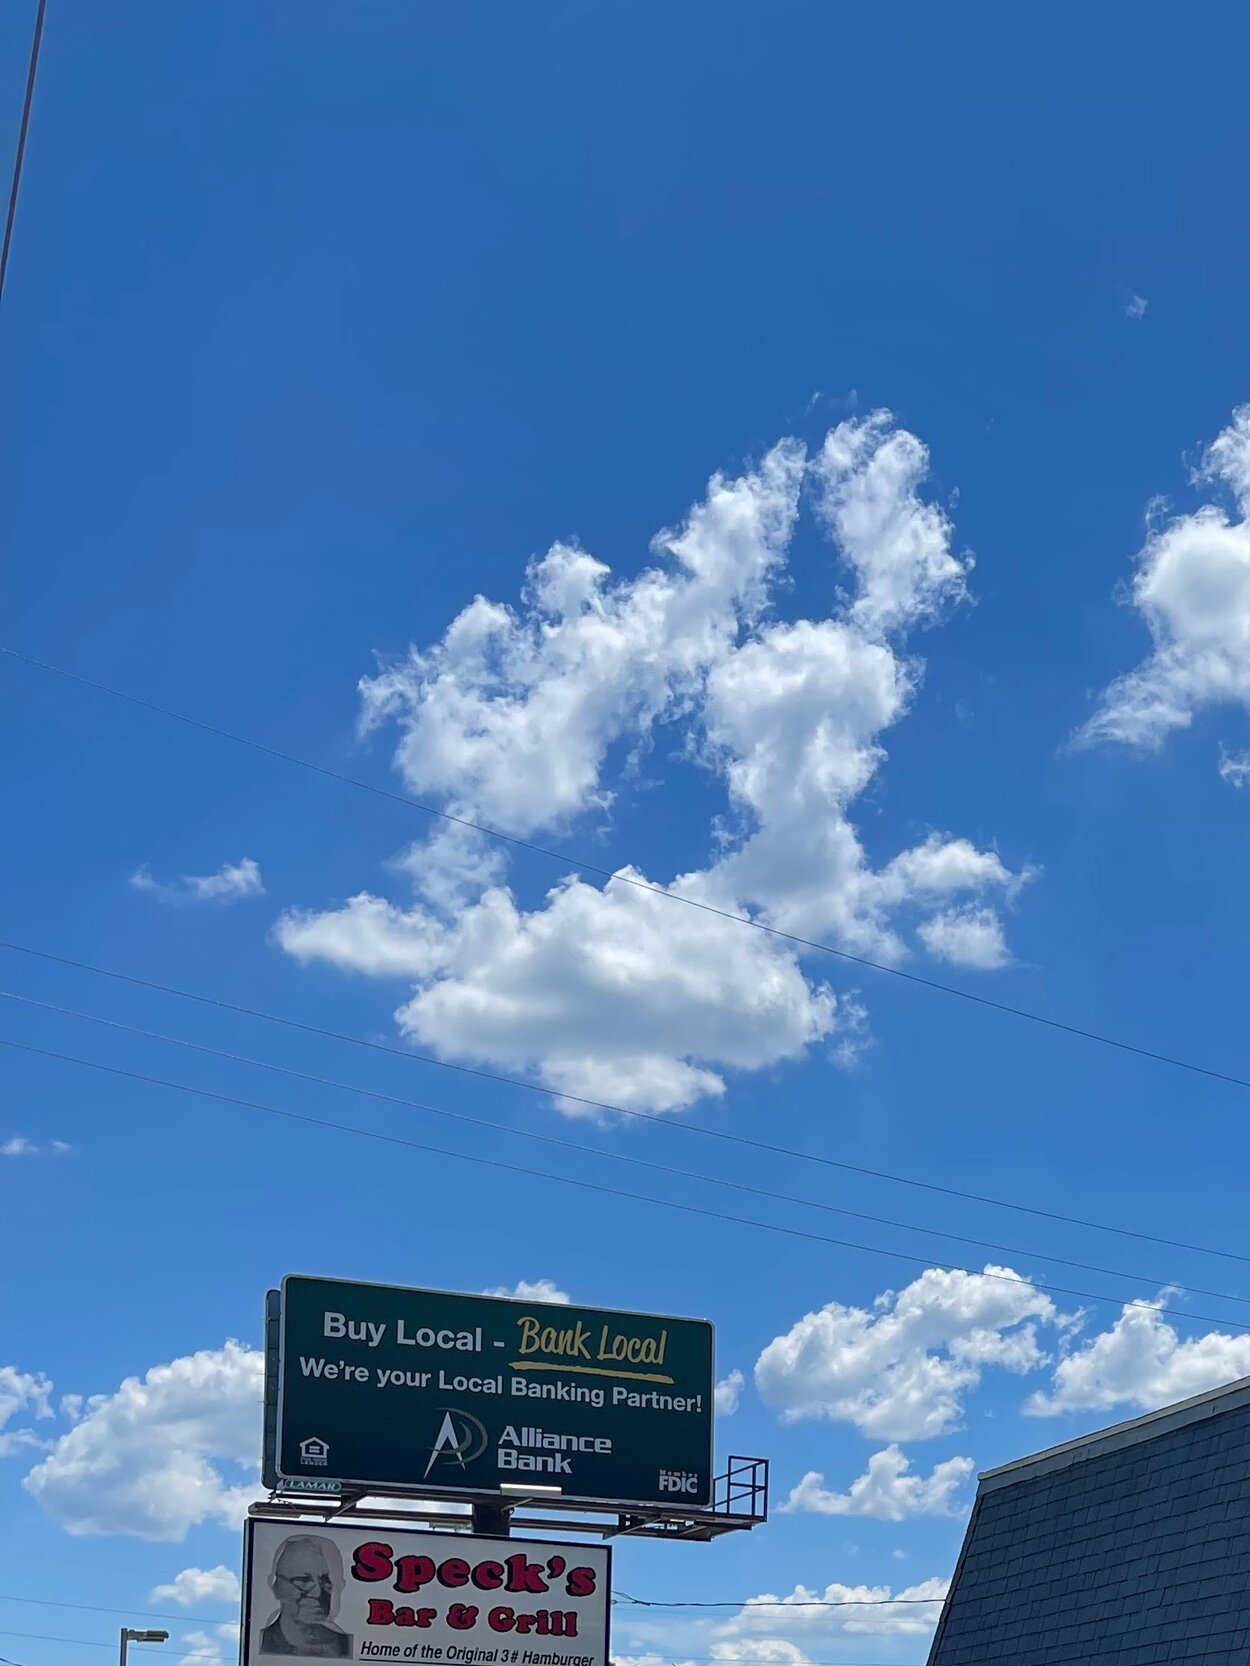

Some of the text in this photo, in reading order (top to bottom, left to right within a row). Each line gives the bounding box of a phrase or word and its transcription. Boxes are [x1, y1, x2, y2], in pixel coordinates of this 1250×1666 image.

[323, 1311, 386, 1347] Buy
[397, 1319, 482, 1352] Local
[516, 1316, 591, 1360] Bank
[597, 1325, 667, 1365] Local
[300, 1356, 702, 1413] We're your Local Banking Partner!
[497, 1425, 612, 1454] Alliance
[497, 1448, 573, 1474] Bank
[290, 1480, 336, 1490] LAMAR
[659, 1475, 698, 1494] FDIC
[351, 1541, 596, 1596] Speck's
[367, 1599, 578, 1638] Bar & Grill
[360, 1641, 400, 1657] Home
[404, 1643, 418, 1658] of
[421, 1644, 443, 1659] the
[446, 1645, 498, 1664] Original
